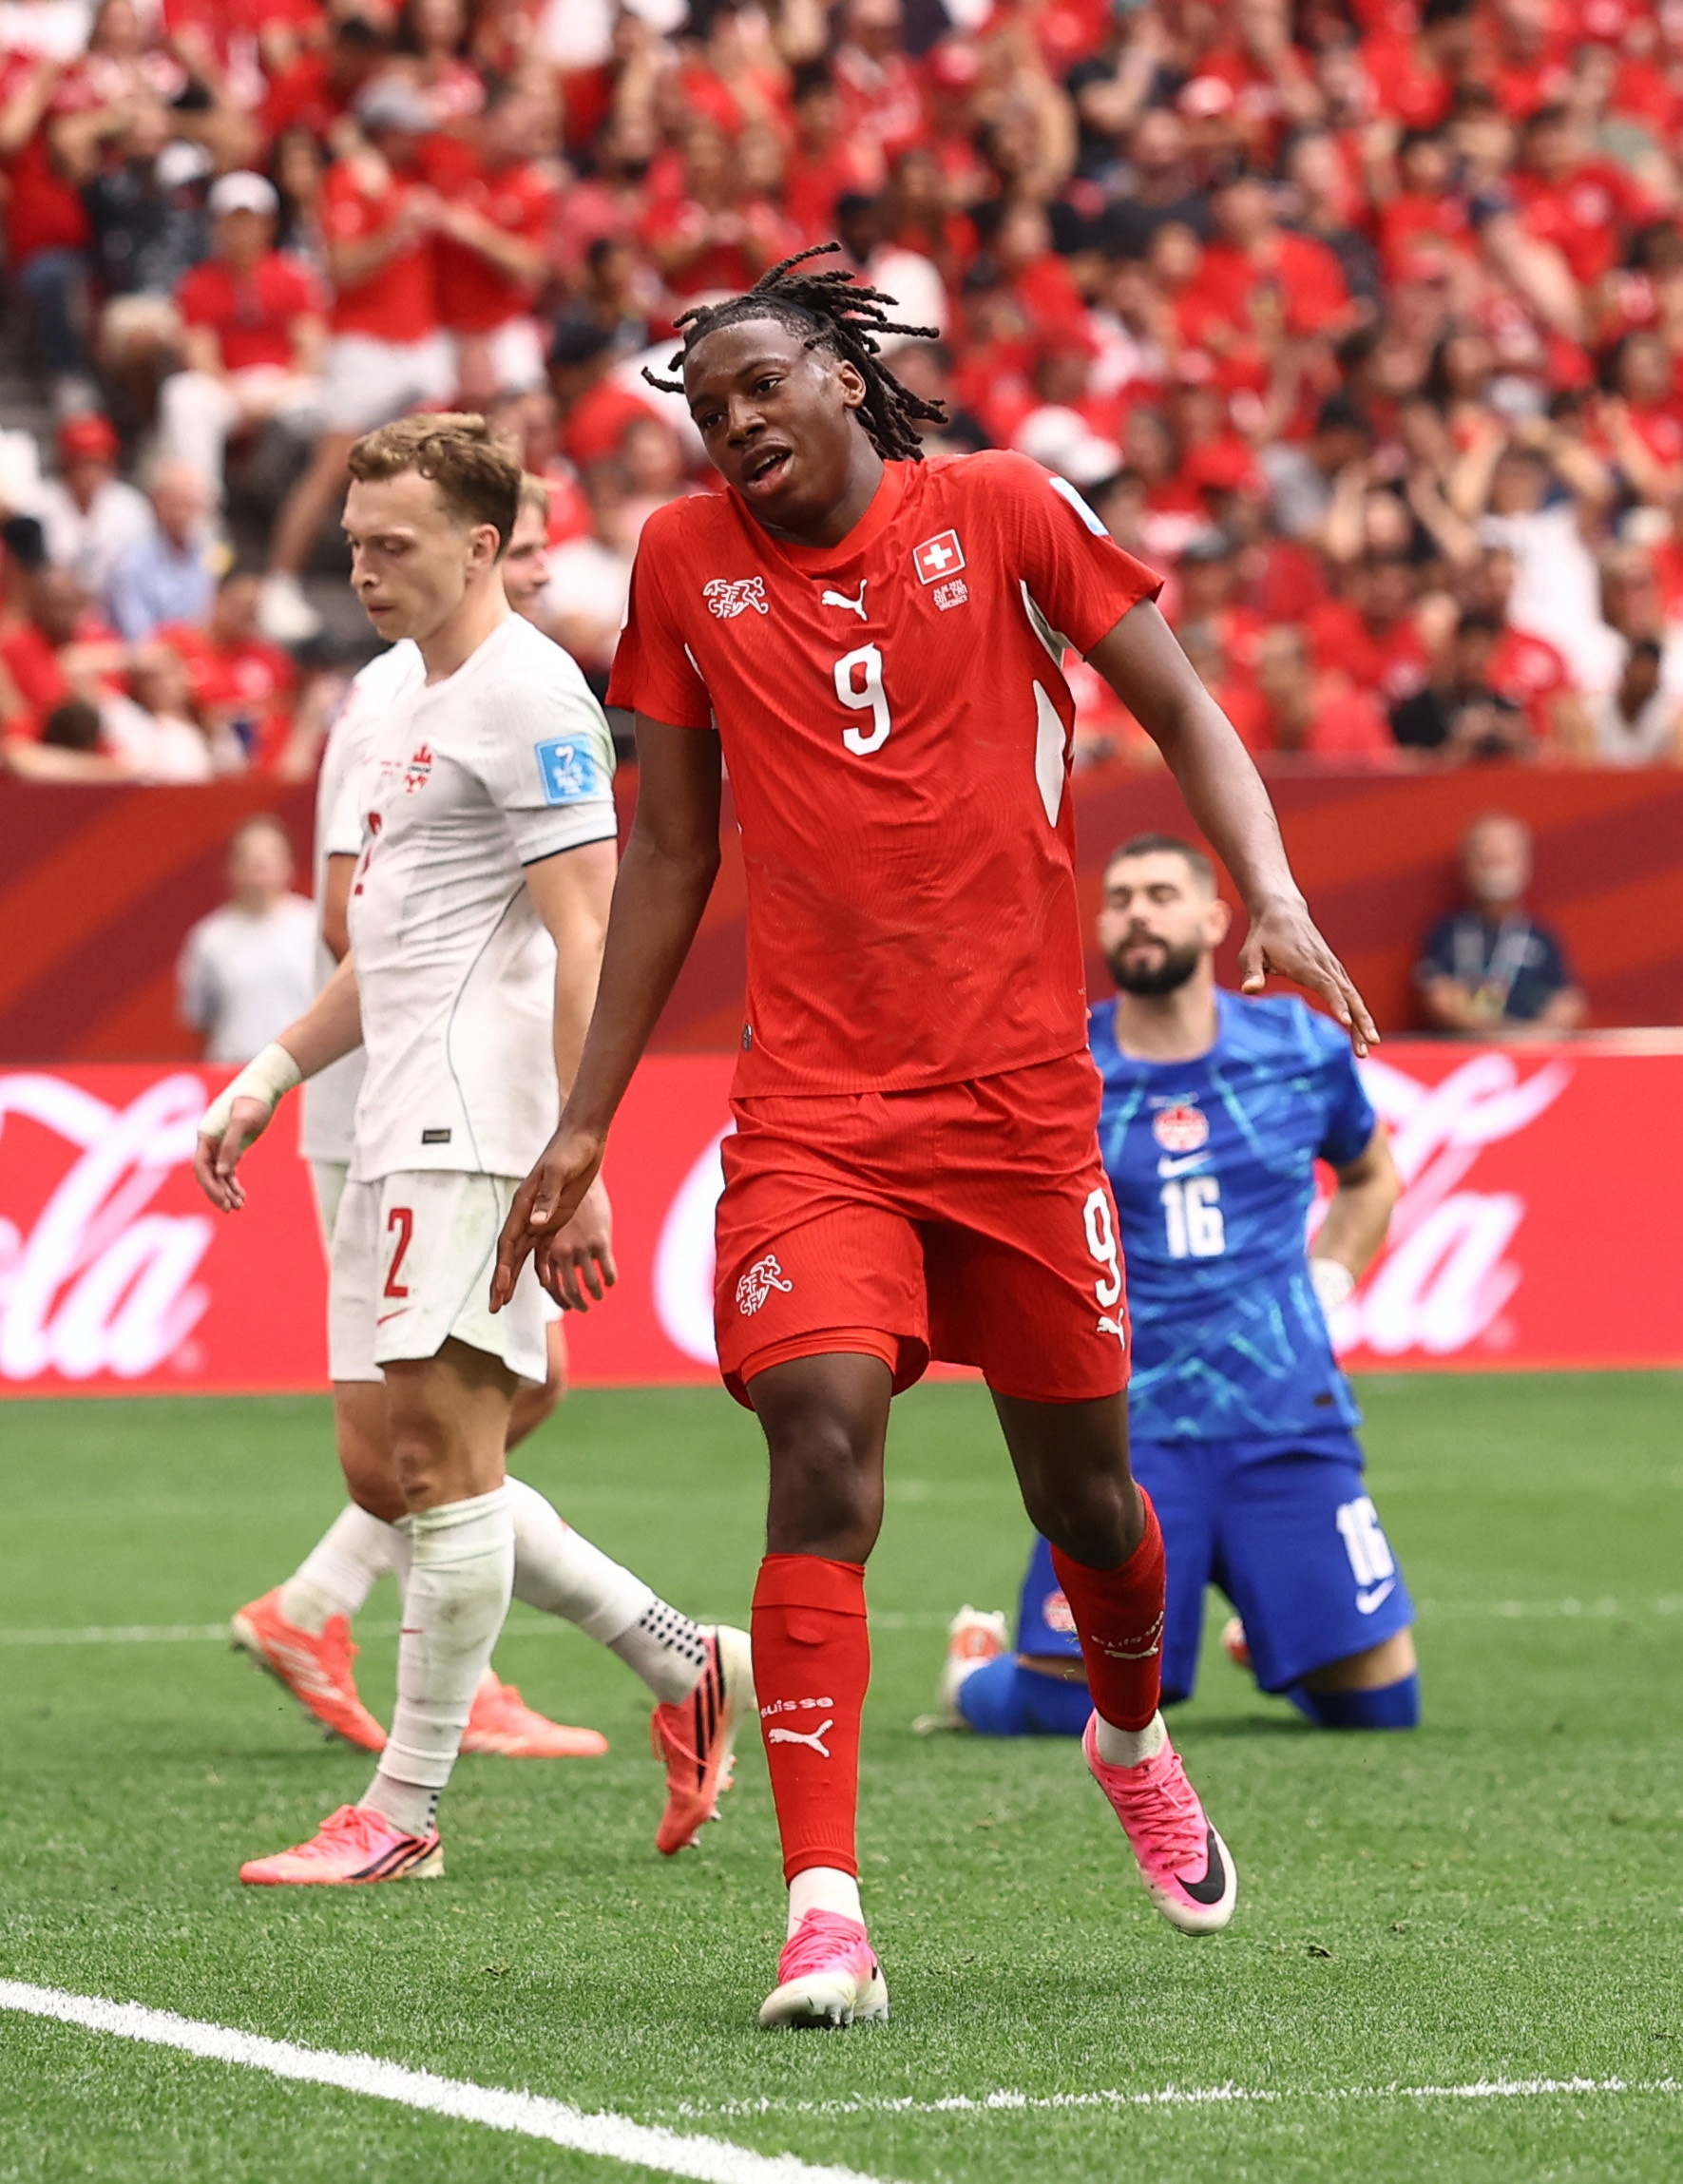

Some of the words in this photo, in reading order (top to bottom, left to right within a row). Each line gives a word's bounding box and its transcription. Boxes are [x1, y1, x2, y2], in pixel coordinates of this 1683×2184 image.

[833, 642, 891, 756] 9
[383, 1207, 413, 1298] 2
[1082, 1187, 1122, 1308] 9
[1159, 1175, 1227, 1260] 16
[1335, 1495, 1396, 1587] 16
